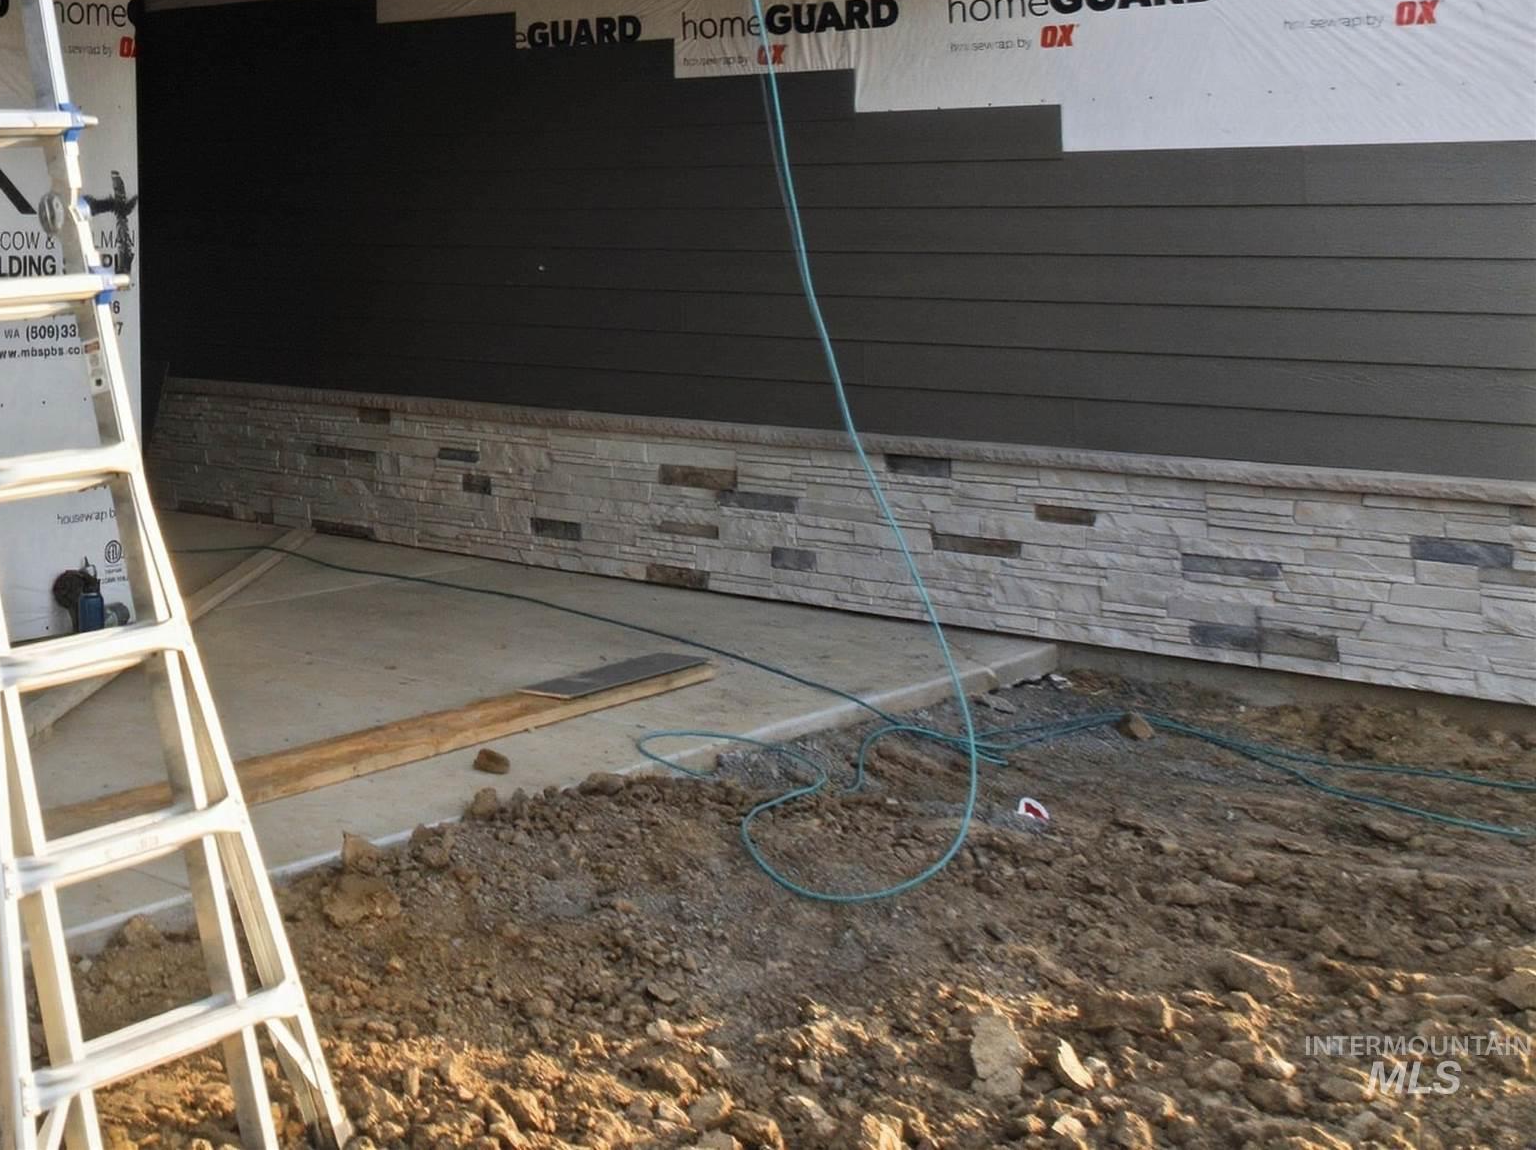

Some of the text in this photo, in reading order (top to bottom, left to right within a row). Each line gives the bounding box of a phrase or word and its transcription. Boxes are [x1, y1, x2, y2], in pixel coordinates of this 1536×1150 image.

[1395, 0, 1441, 26] OX
[1040, 24, 1076, 48] OX
[44, 232, 56, 249] &
[4, 329, 21, 339] WA
